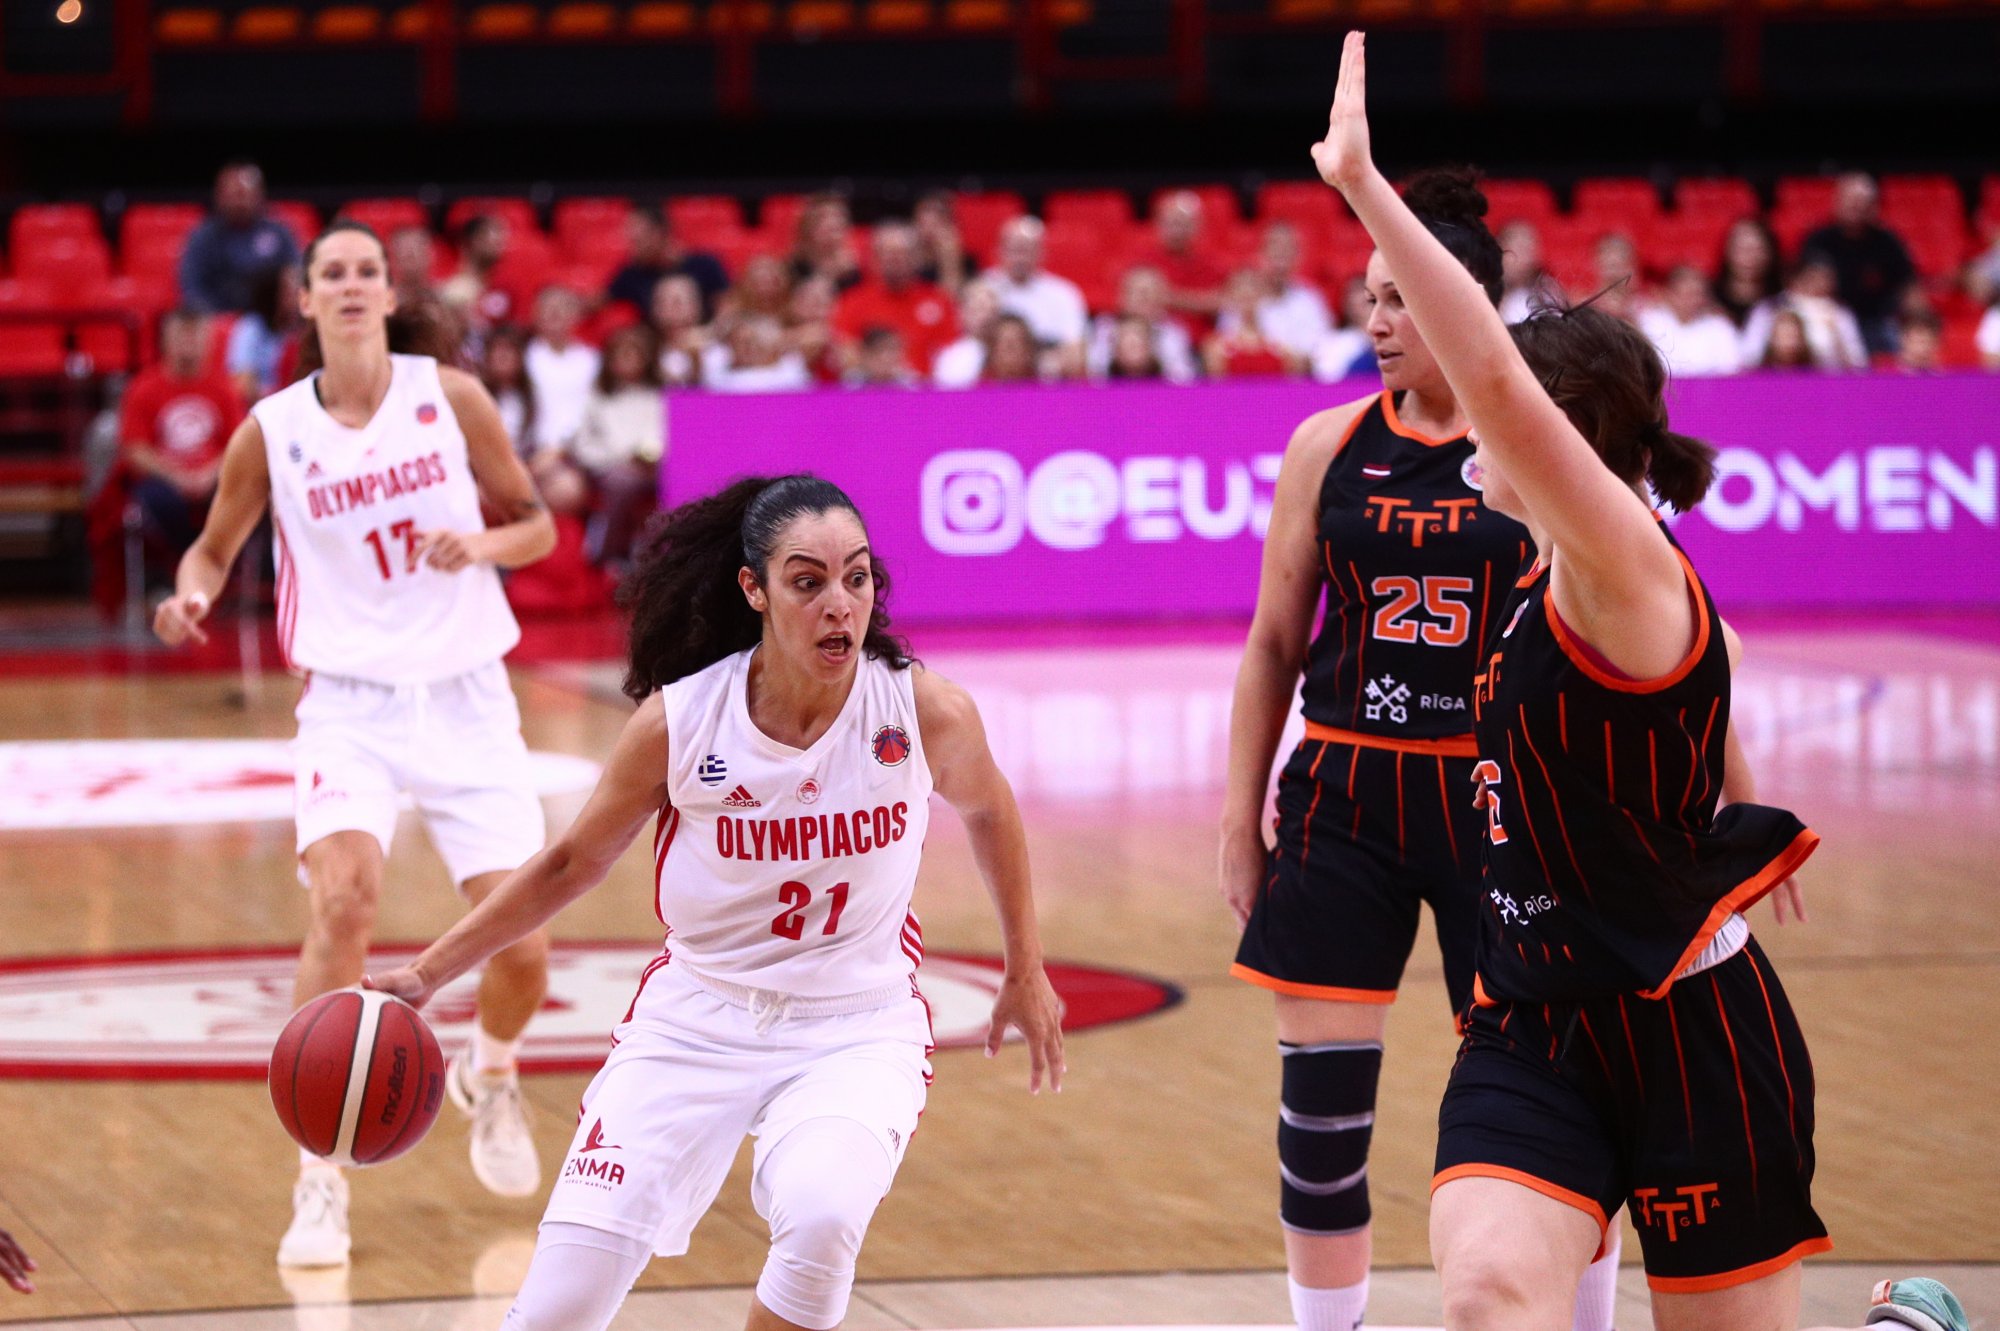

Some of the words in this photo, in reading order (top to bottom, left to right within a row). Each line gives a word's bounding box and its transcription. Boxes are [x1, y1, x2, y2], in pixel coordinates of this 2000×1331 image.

[307, 451, 446, 519] OLYMPIACOS
[1645, 446, 1998, 532] OMEN
[364, 518, 418, 580] 17
[1371, 575, 1473, 647] 25
[717, 801, 908, 861] OLYMPIACOS
[721, 799, 761, 807] adidas
[771, 880, 850, 941] 21
